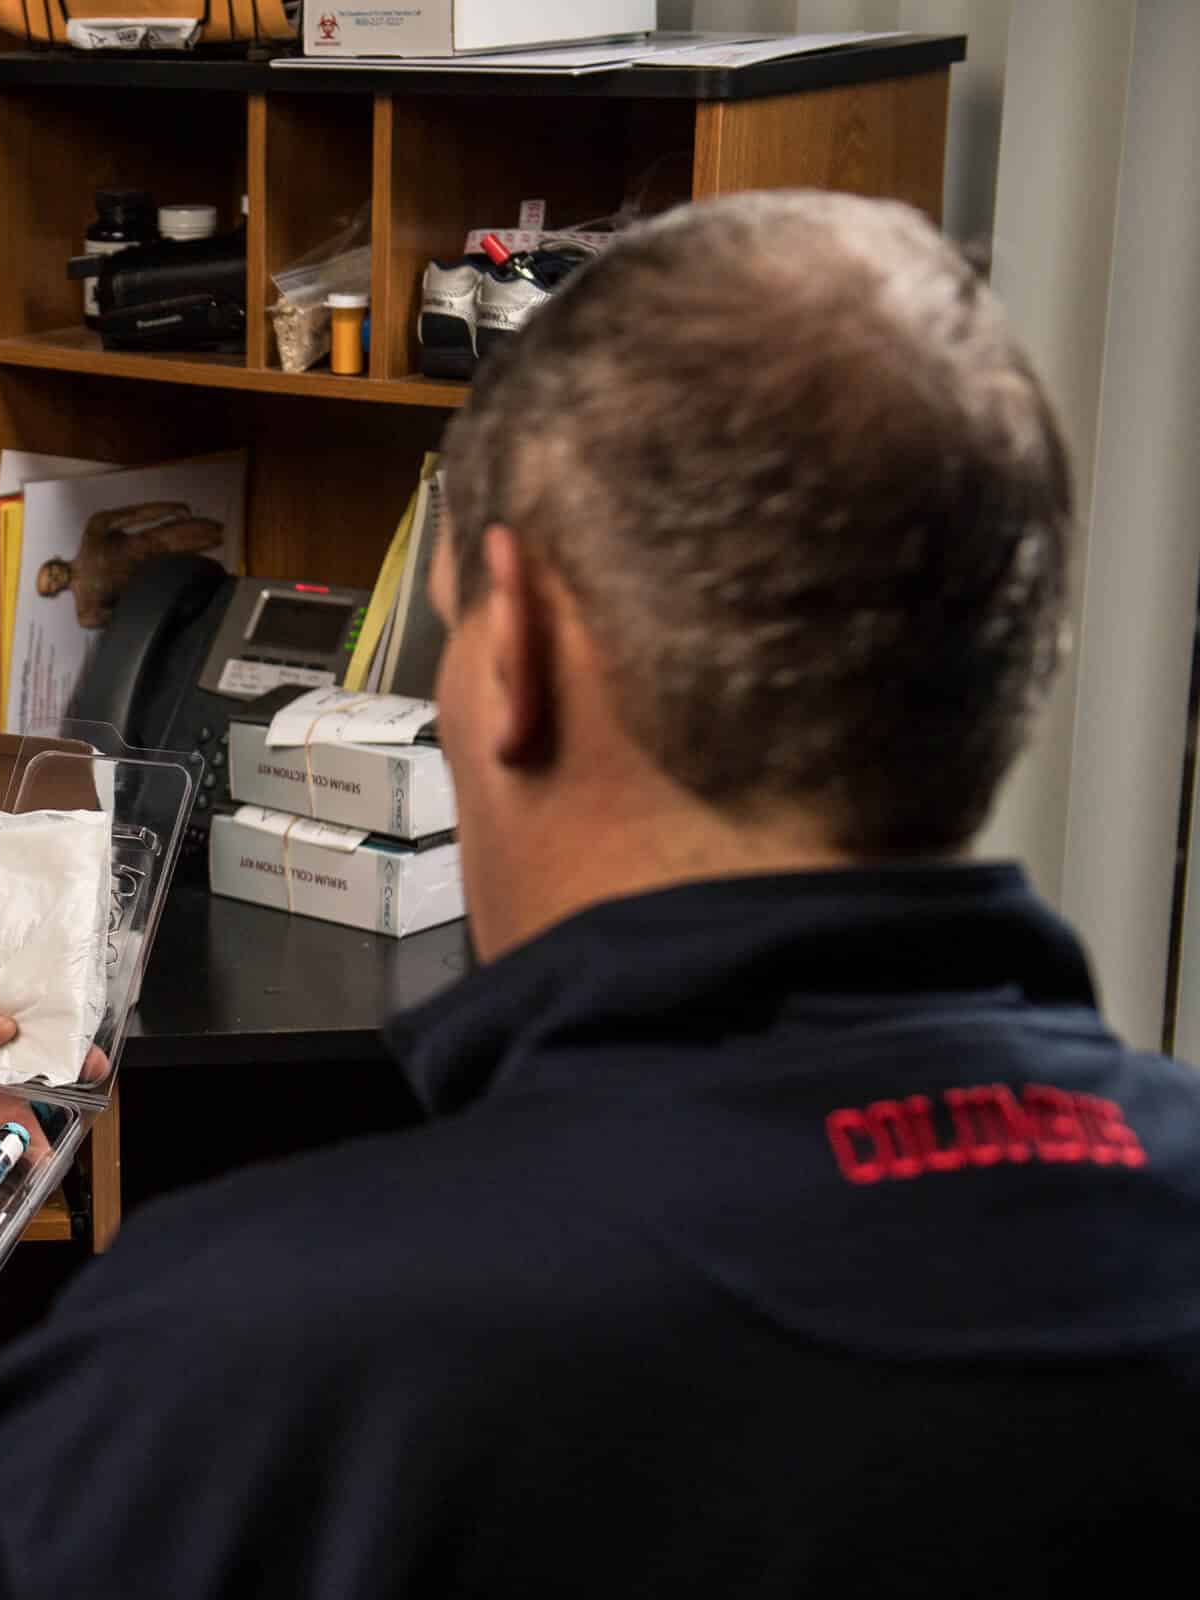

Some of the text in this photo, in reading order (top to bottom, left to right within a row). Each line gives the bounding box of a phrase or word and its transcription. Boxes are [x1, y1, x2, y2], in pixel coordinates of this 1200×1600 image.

[257, 762, 361, 795] SERUM COLECTION KIT
[240, 855, 348, 891] SERUM COLLCTION KIT
